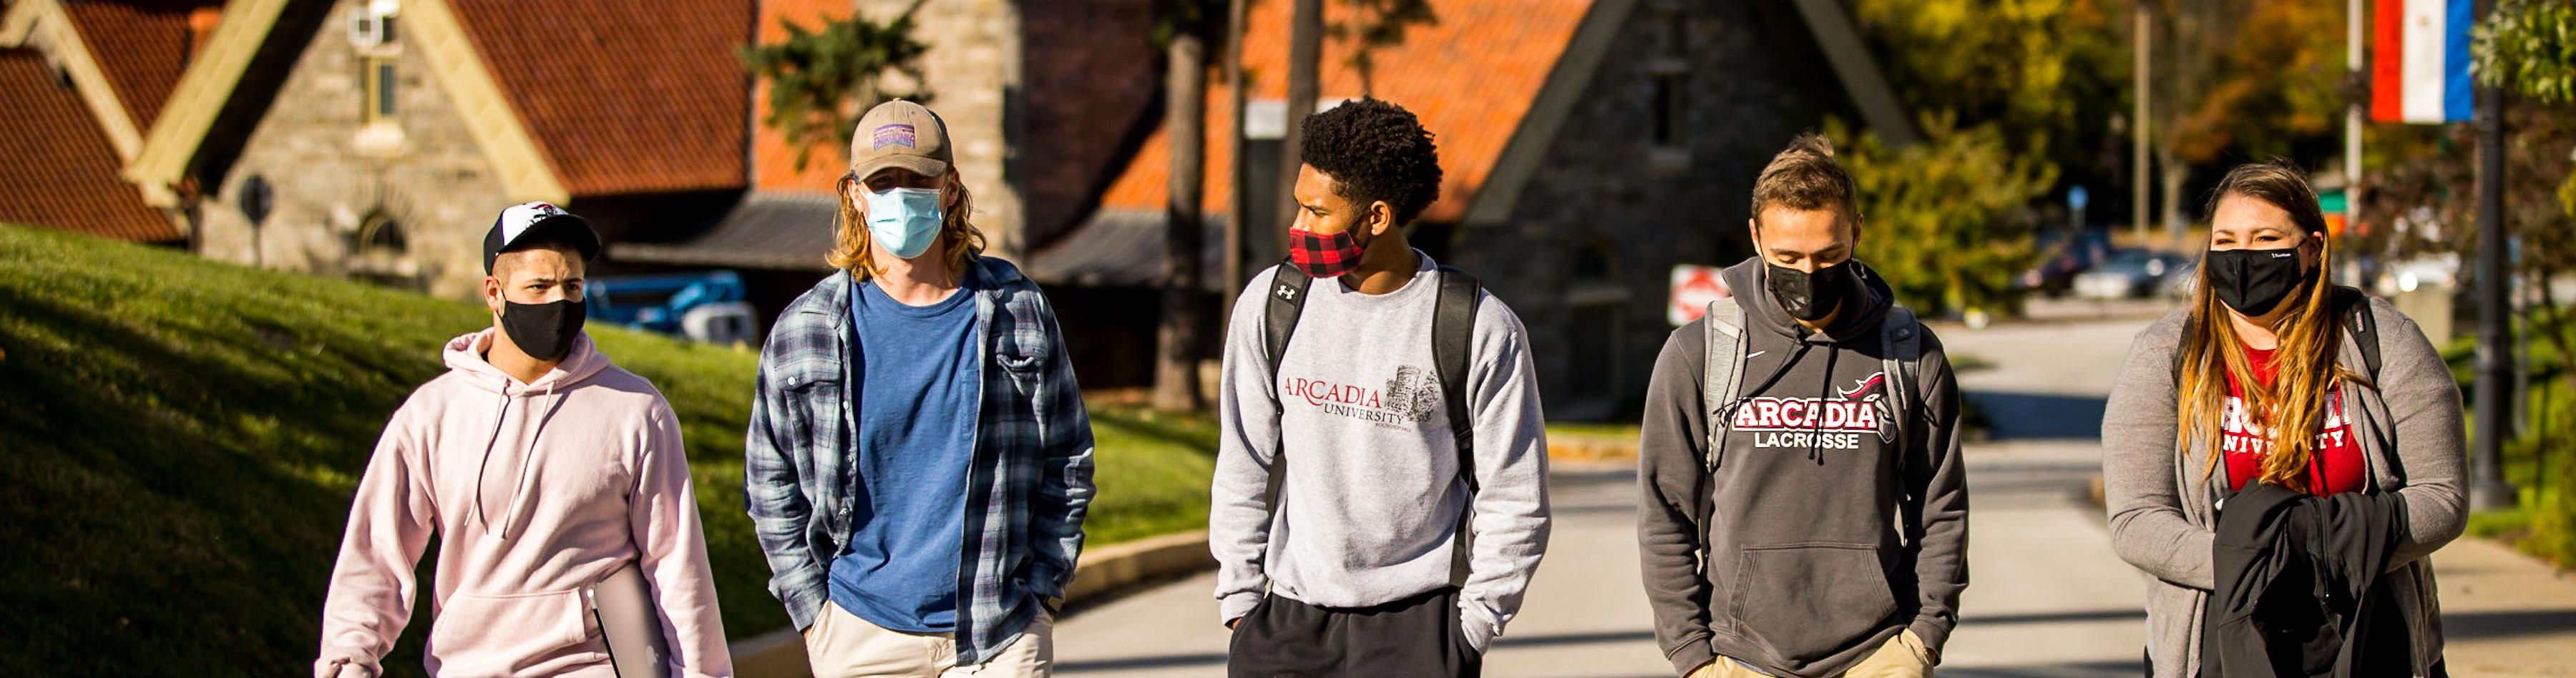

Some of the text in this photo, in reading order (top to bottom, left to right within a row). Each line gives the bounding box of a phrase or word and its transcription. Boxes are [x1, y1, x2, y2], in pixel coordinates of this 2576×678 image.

[1286, 377, 1382, 408] ARCADIA
[1324, 403, 1404, 425] UNIVERSITY
[1735, 400, 1878, 429] ARCADIA
[1754, 432, 1859, 449] LACROSSE
